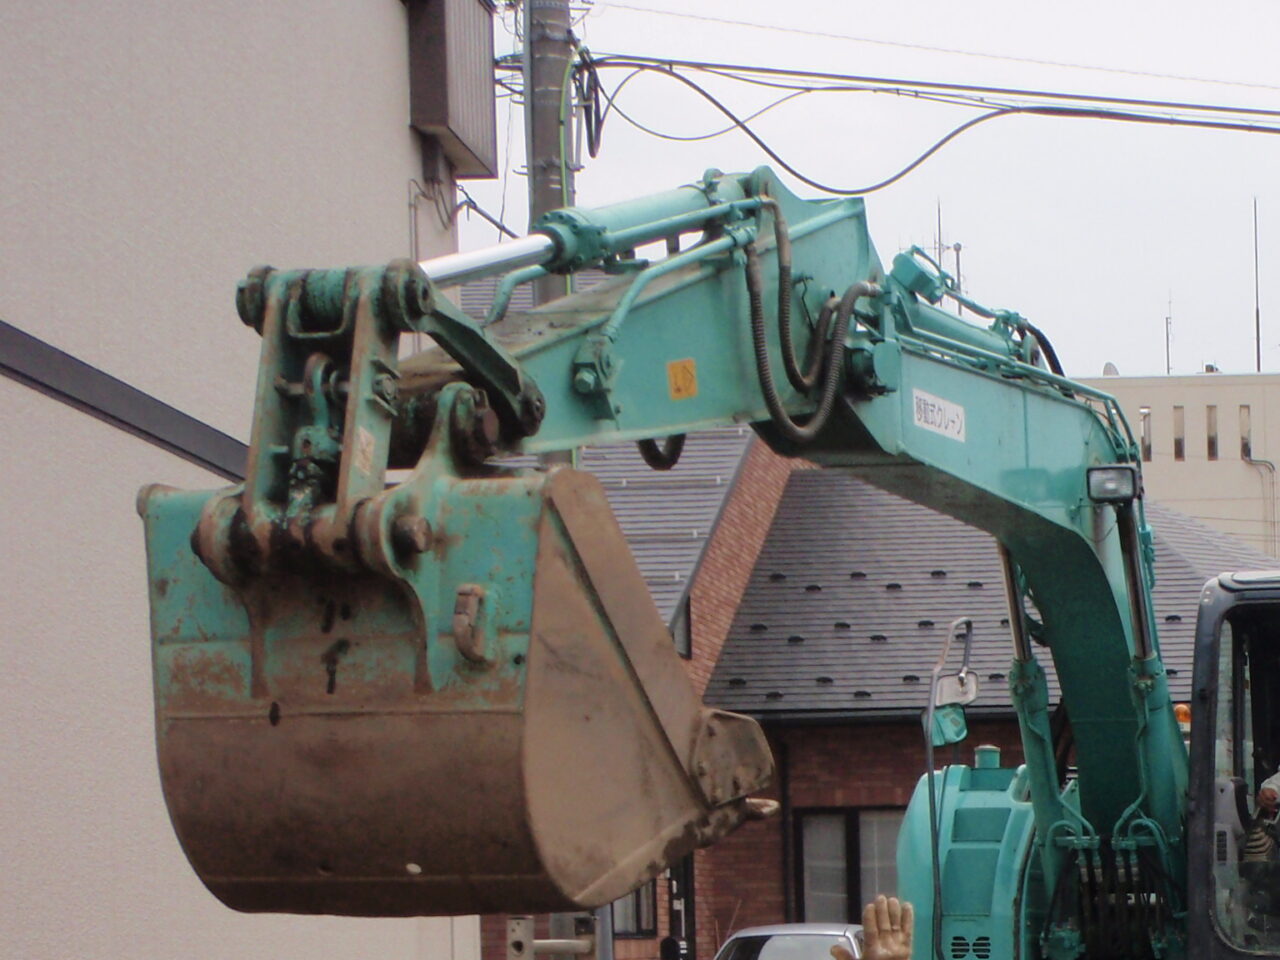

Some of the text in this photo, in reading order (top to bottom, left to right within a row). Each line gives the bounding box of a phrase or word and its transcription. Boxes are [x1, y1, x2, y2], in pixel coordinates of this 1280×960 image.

[914, 395, 963, 435] 移動式クレーン
